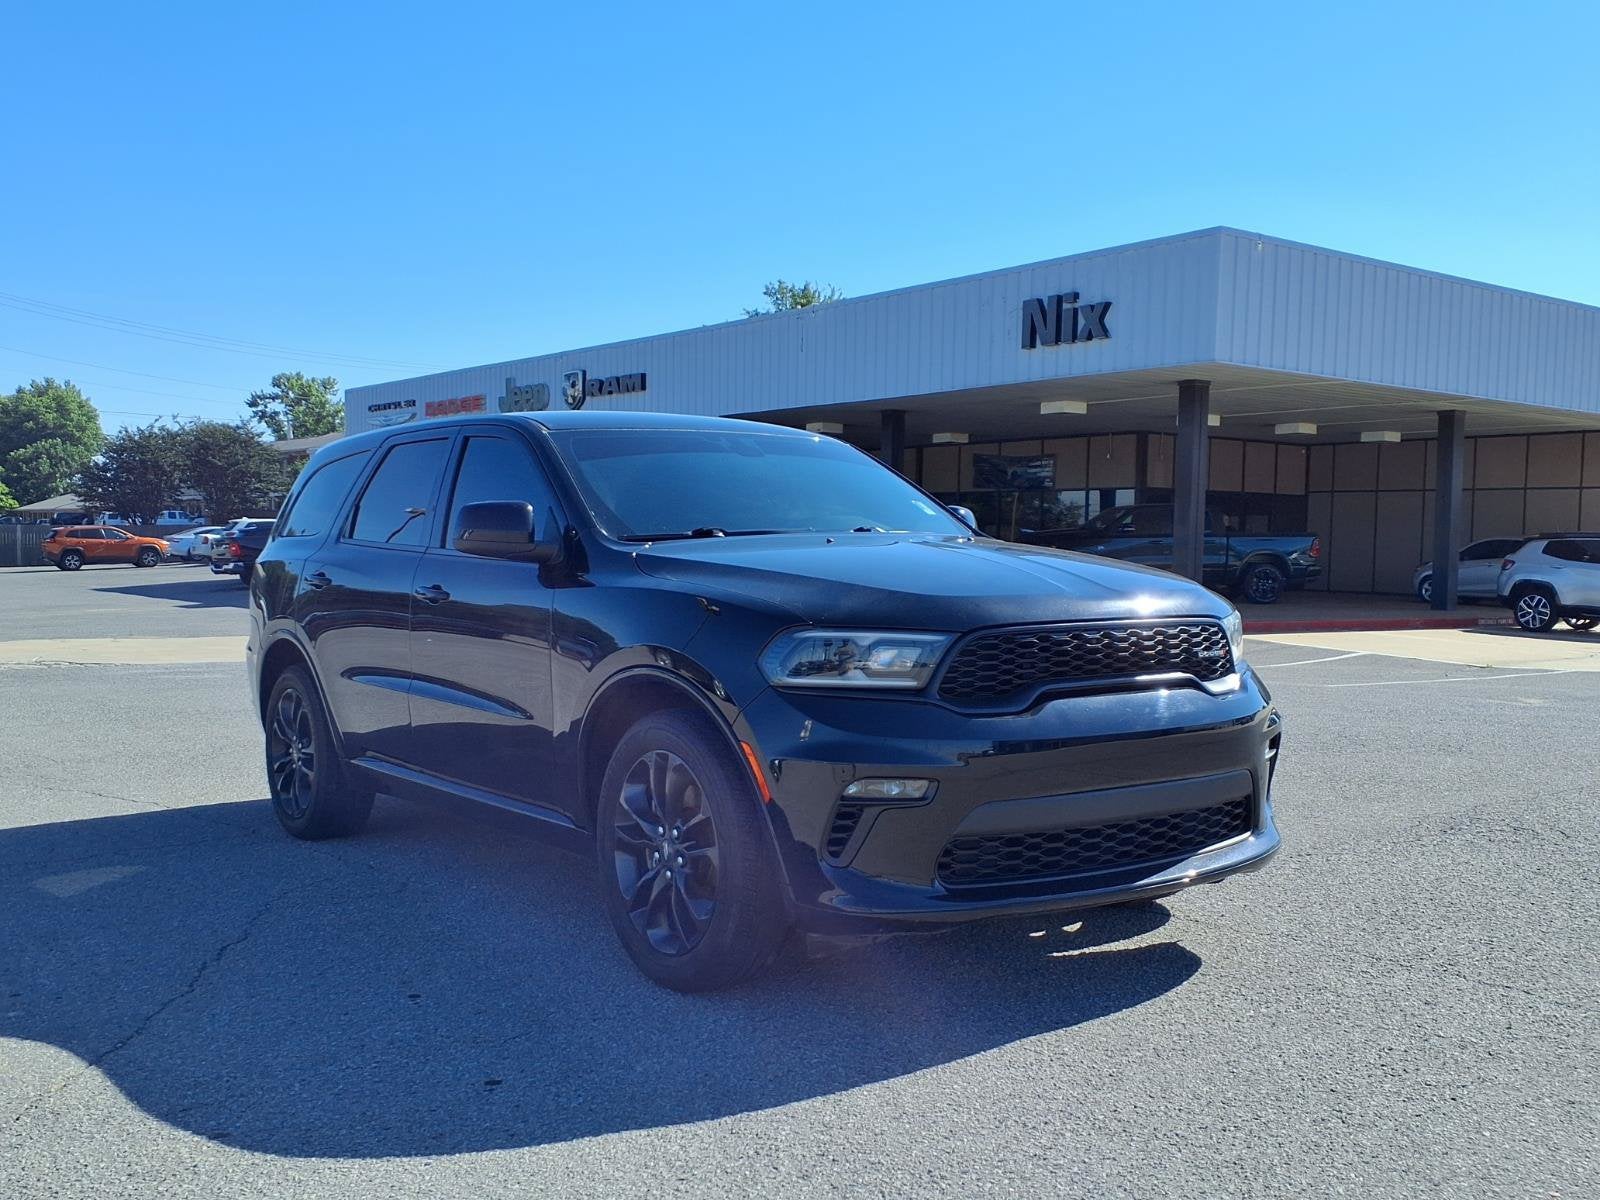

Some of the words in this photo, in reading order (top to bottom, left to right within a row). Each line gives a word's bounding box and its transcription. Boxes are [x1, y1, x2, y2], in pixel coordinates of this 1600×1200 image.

[1021, 291, 1112, 350] Nix
[498, 377, 550, 412] Jeep
[587, 372, 646, 397] RAM
